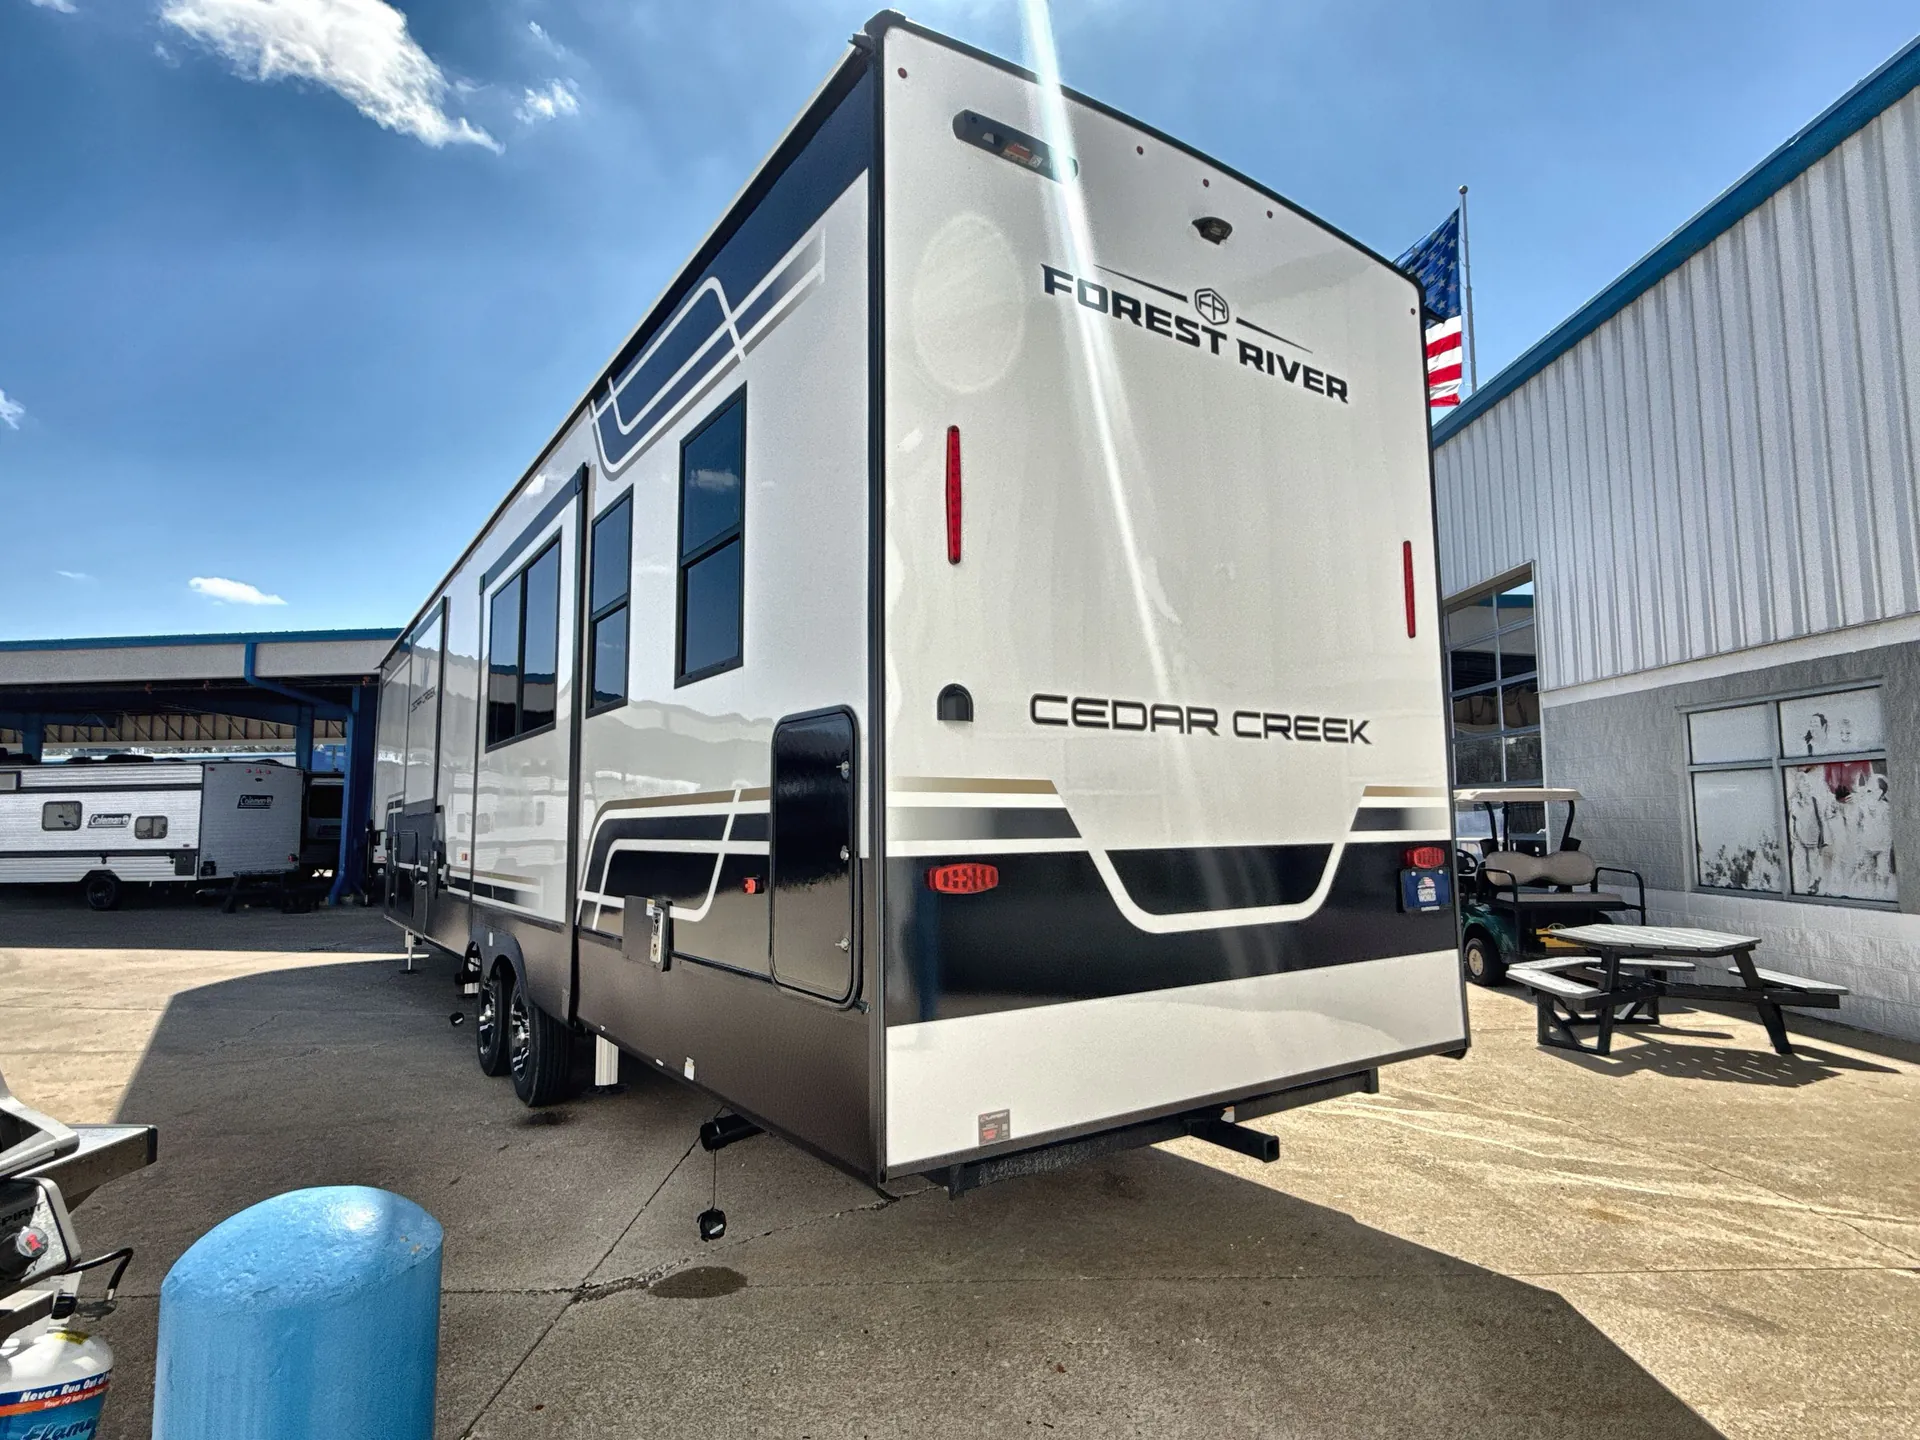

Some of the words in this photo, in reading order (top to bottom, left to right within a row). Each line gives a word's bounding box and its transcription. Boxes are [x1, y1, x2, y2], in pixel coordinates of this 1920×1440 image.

[1041, 263, 1227, 355] FOREST
[1236, 338, 1349, 404] RIVER
[1030, 693, 1220, 736] CEDAR
[1233, 710, 1372, 745] CREEK
[239, 795, 267, 806] Coleman
[90, 814, 122, 826] Coleman
[19, 1388, 58, 1403] Never
[60, 1383, 81, 1396] Run
